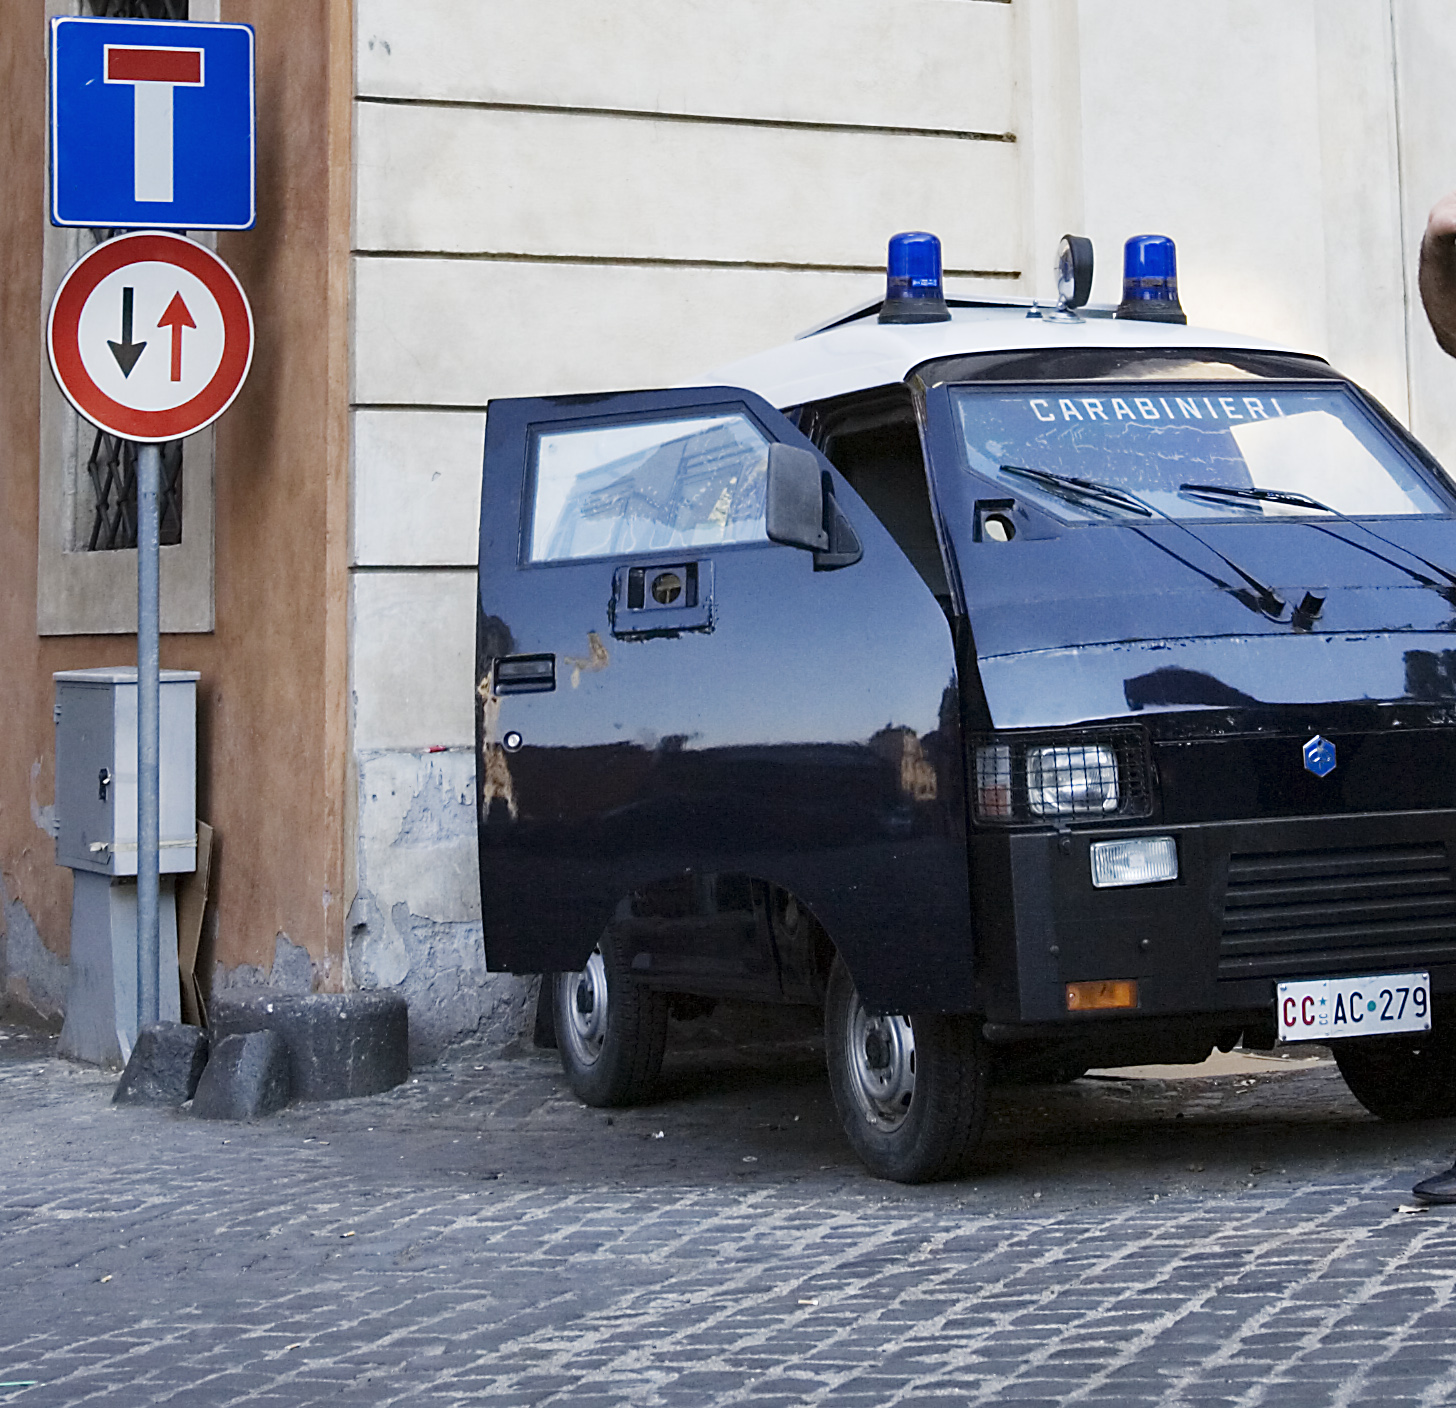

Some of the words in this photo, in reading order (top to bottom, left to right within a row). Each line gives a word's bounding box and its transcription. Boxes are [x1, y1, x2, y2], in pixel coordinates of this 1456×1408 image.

[1029, 397, 1286, 422] CARABINIERI
[1283, 995, 1315, 1027] CC
[1334, 991, 1364, 1025] AC
[1379, 986, 1427, 1022] 279
